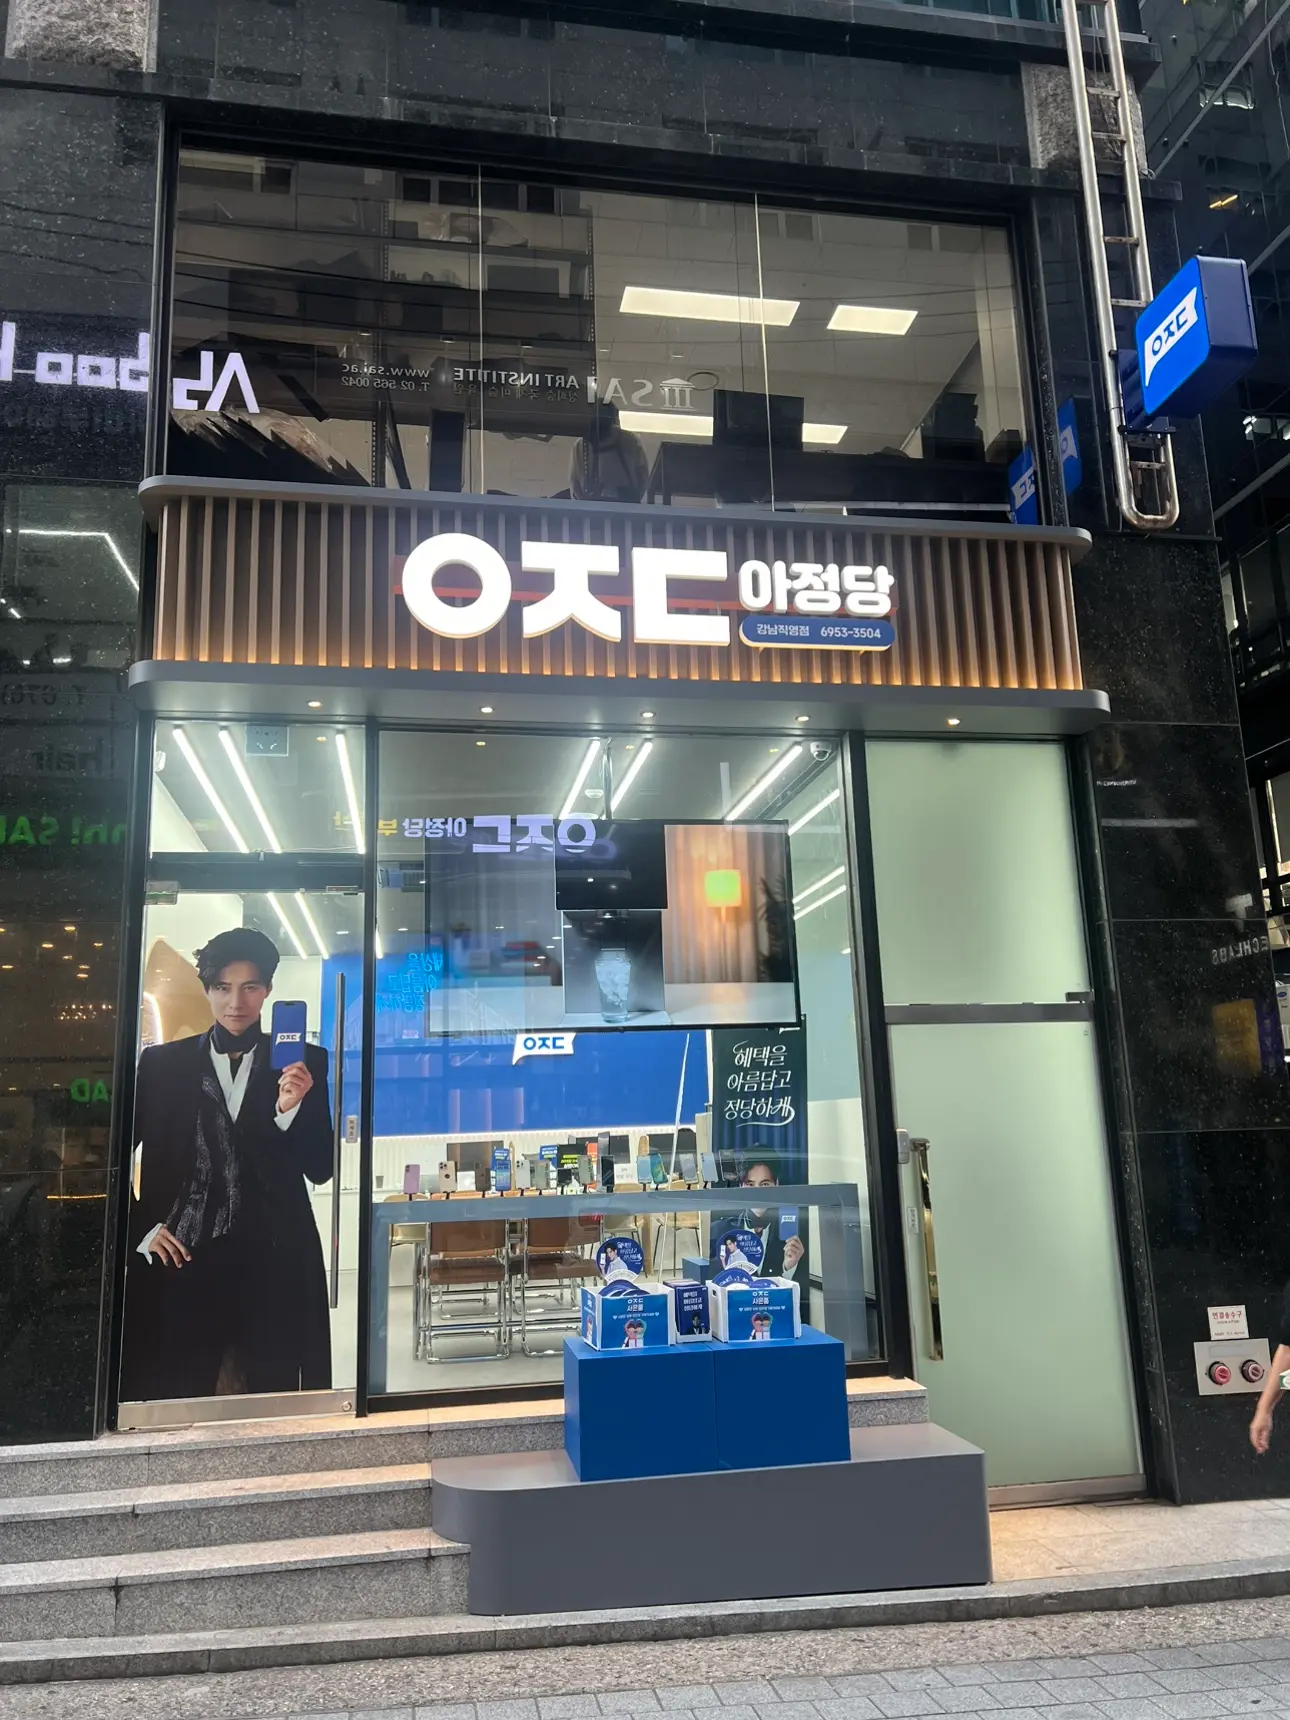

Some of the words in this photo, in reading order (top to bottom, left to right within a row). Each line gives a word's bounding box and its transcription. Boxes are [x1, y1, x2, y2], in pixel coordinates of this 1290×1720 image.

[402, 533, 730, 646] ㅇㅈㄷ
[738, 560, 895, 618] 아정당
[756, 623, 810, 637] 강남직영점
[820, 626, 881, 639] 6953-3504
[733, 1041, 788, 1068] 혜택을
[727, 1069, 791, 1093] 아름답고
[724, 1096, 796, 1125] 정당하게
